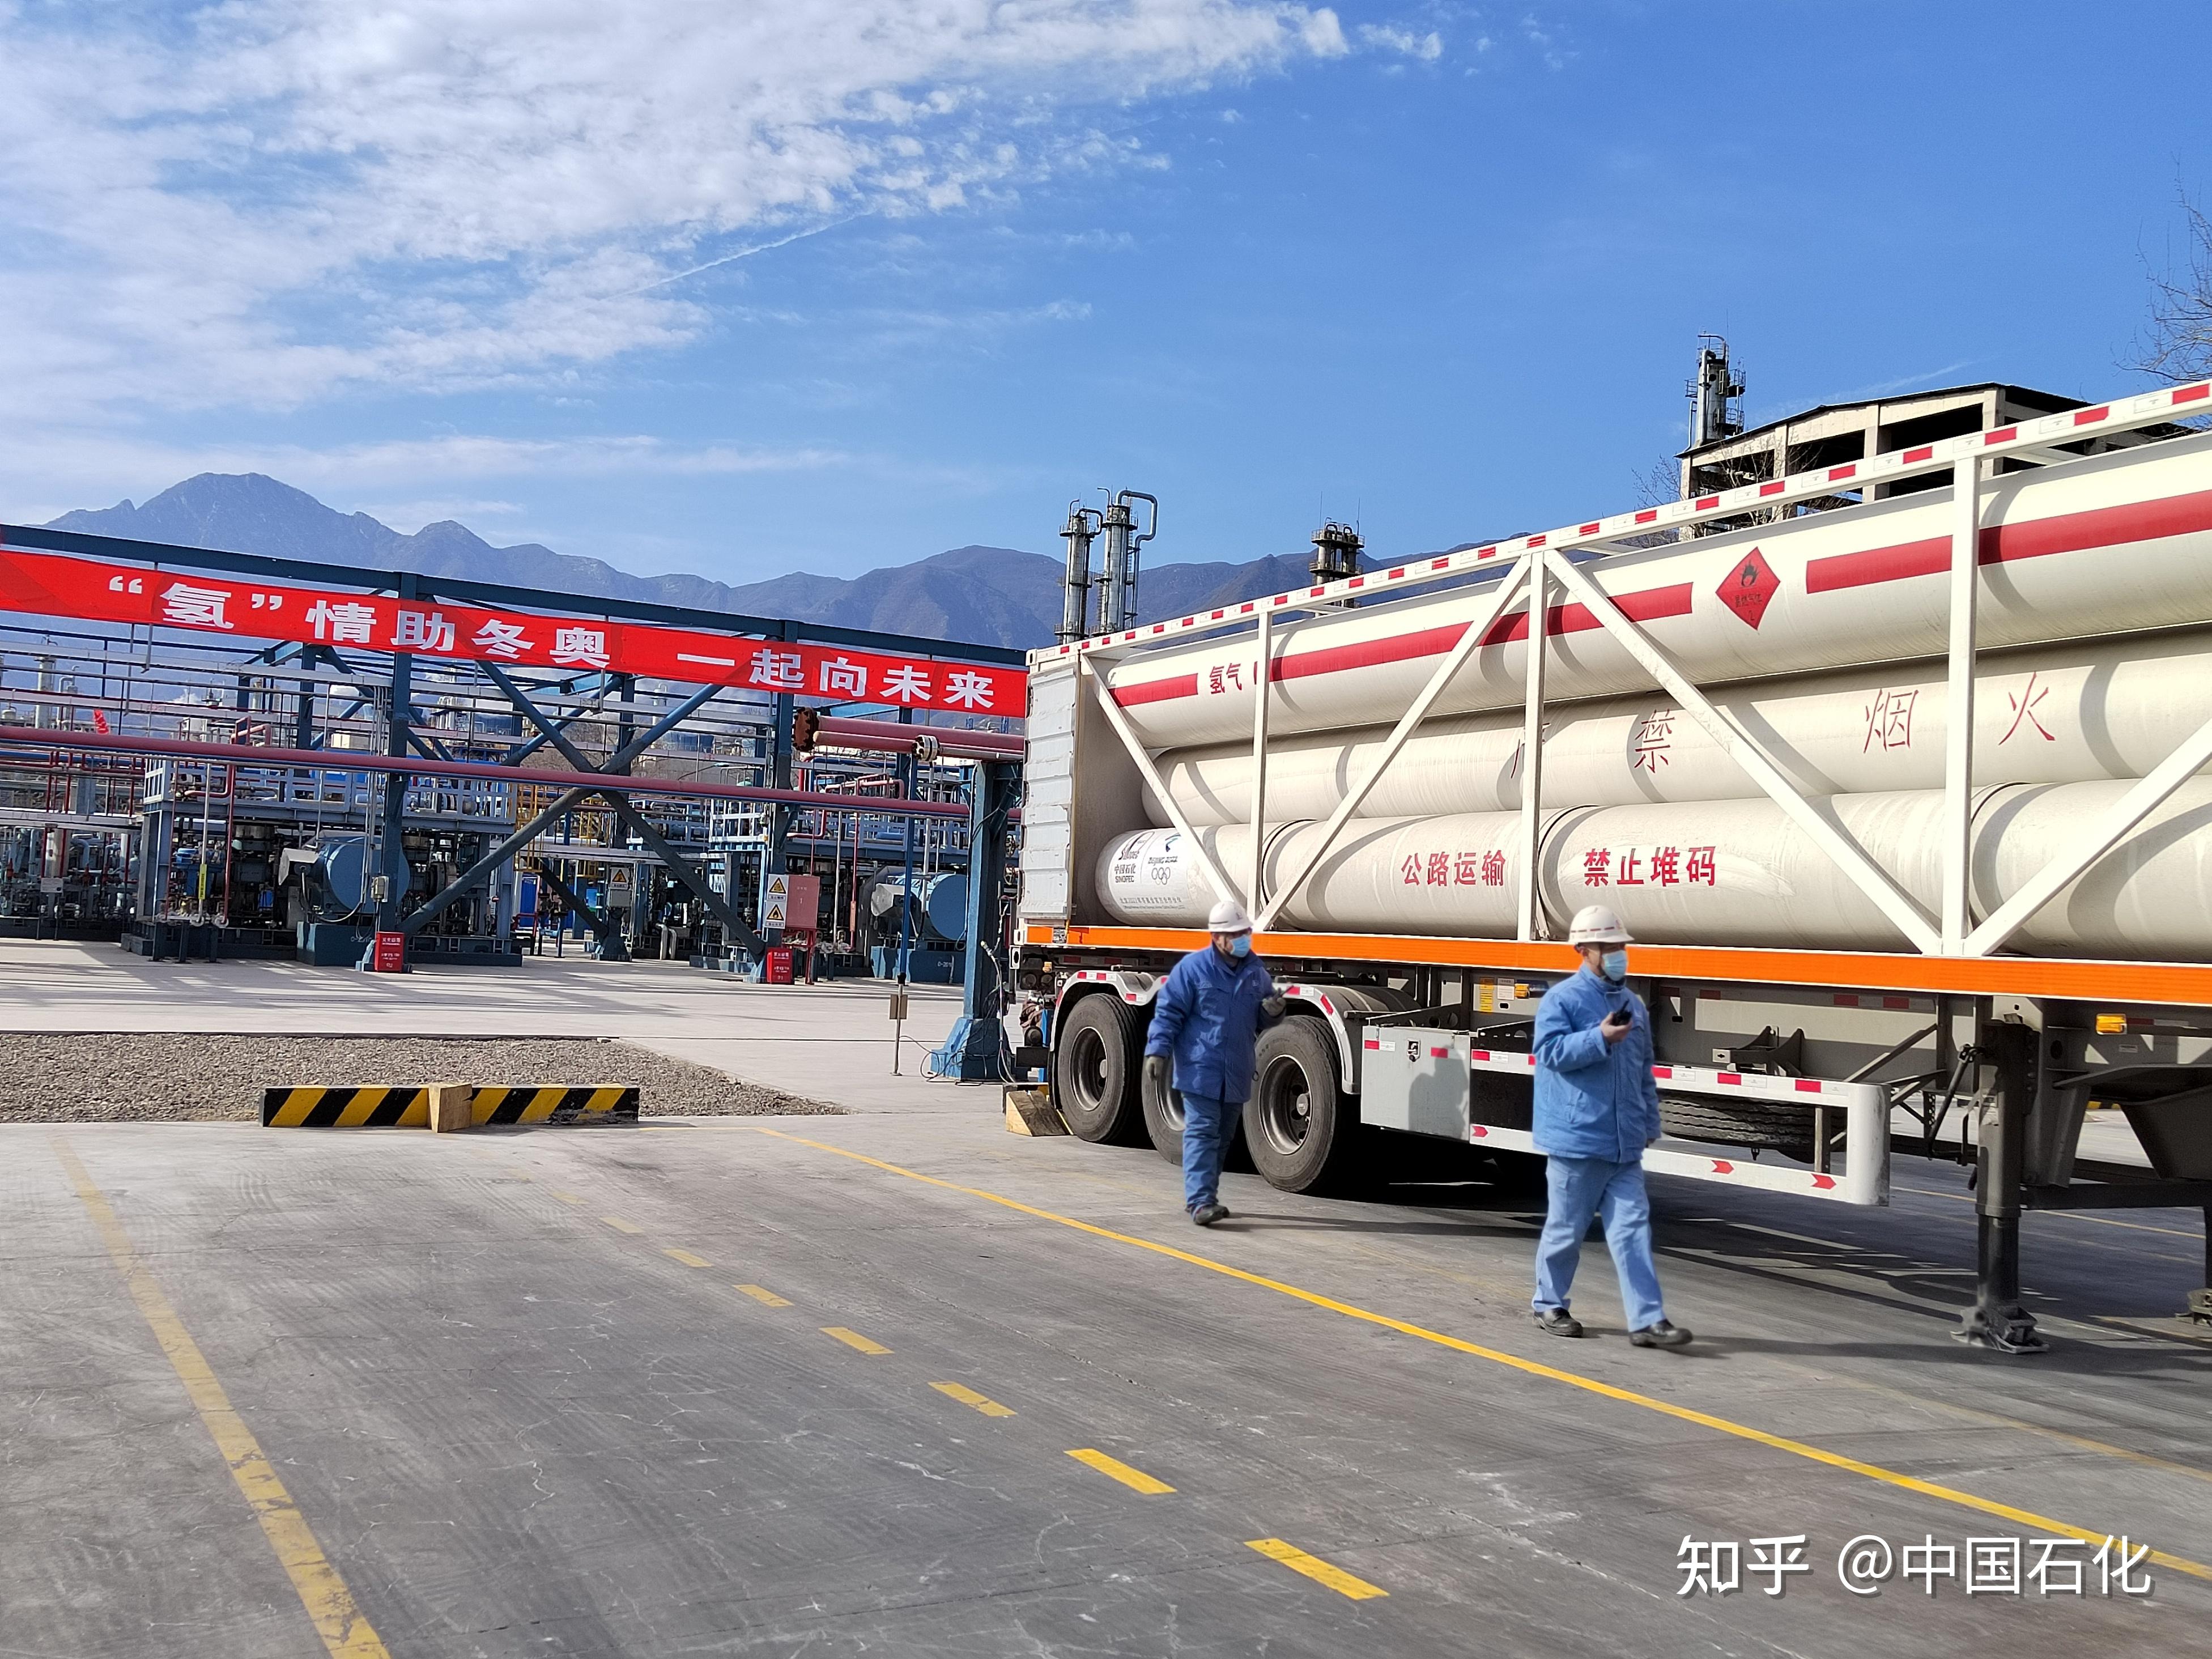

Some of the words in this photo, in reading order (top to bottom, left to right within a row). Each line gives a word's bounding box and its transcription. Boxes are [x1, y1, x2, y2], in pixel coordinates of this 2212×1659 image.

[677, 649, 994, 709] 一起向未来
[1209, 663, 1243, 695] 氢气
[1114, 863, 1136, 874] 中国石化
[1401, 849, 1506, 887] 公路运输
[1583, 845, 1717, 888] 禁止堆码
